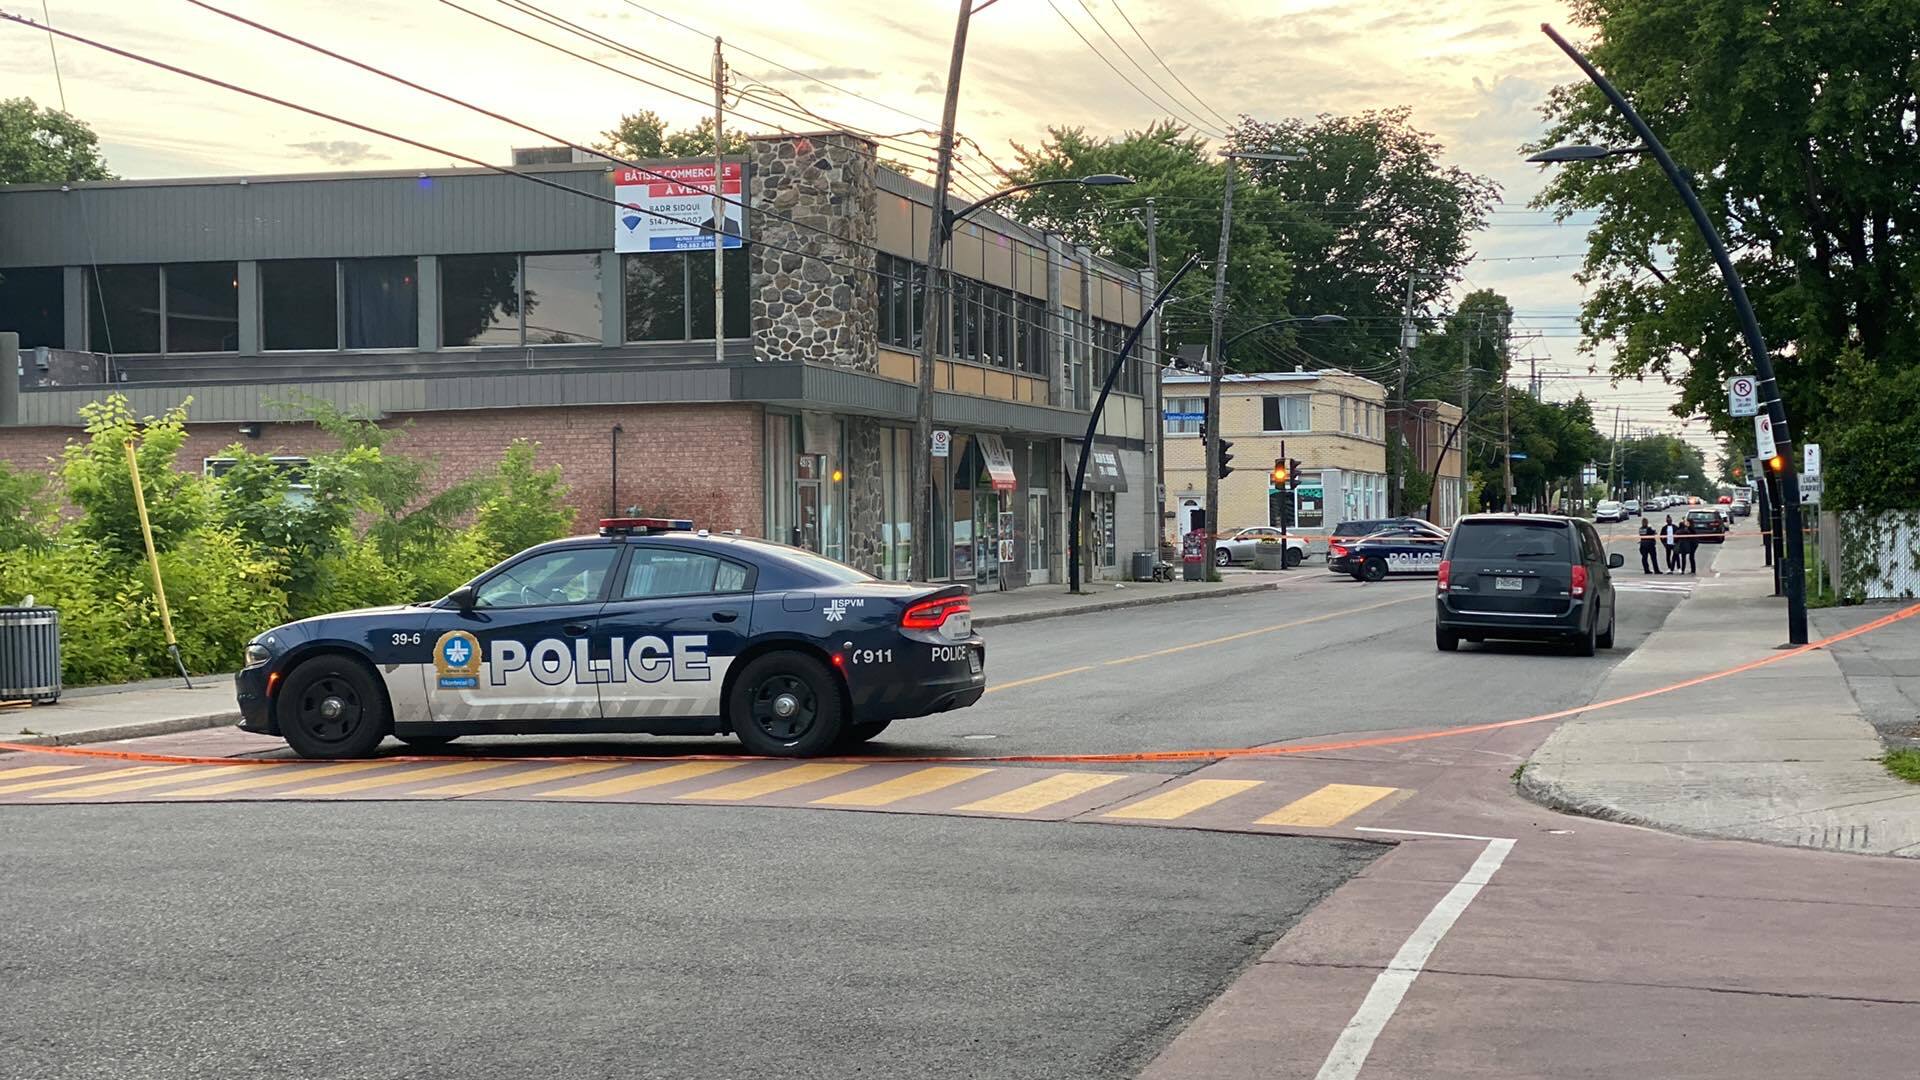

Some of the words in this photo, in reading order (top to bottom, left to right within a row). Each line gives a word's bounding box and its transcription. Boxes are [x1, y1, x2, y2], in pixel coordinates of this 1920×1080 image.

[664, 167, 731, 179] COMMERCIE
[665, 185, 674, 195] À
[678, 184, 724, 195] VENDR
[1389, 552, 1441, 564] POLICE
[838, 599, 865, 607] SPVM
[391, 633, 421, 646] 39-6
[864, 649, 893, 664] 911
[931, 645, 967, 662] POLICE
[490, 635, 712, 686] POLICE
